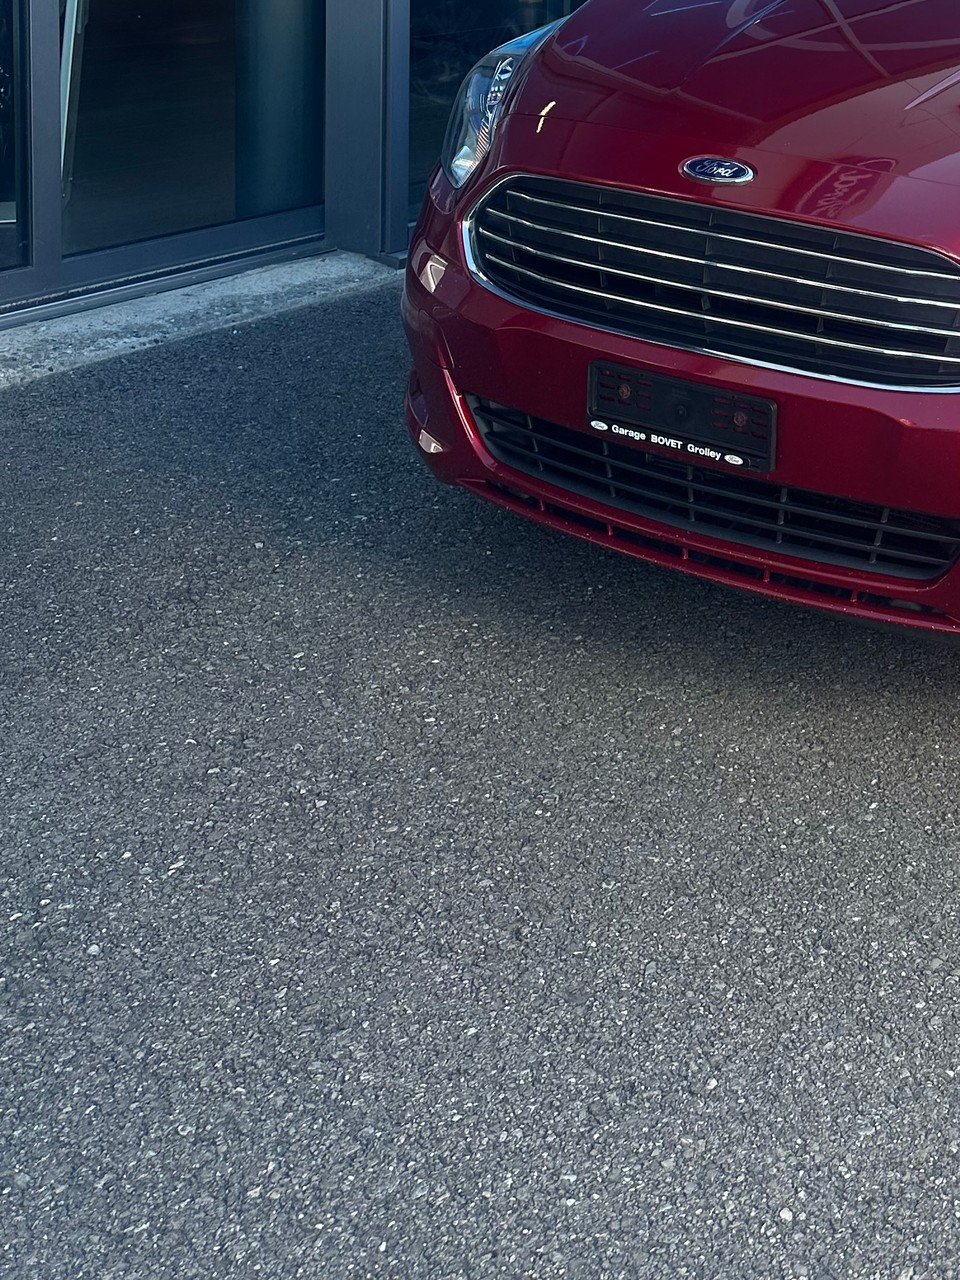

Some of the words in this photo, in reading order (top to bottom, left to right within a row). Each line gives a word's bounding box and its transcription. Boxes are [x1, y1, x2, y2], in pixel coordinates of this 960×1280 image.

[695, 160, 739, 177] Ford
[612, 424, 646, 440] Garage
[650, 434, 683, 449] BOVET
[687, 444, 722, 461] Grolley
